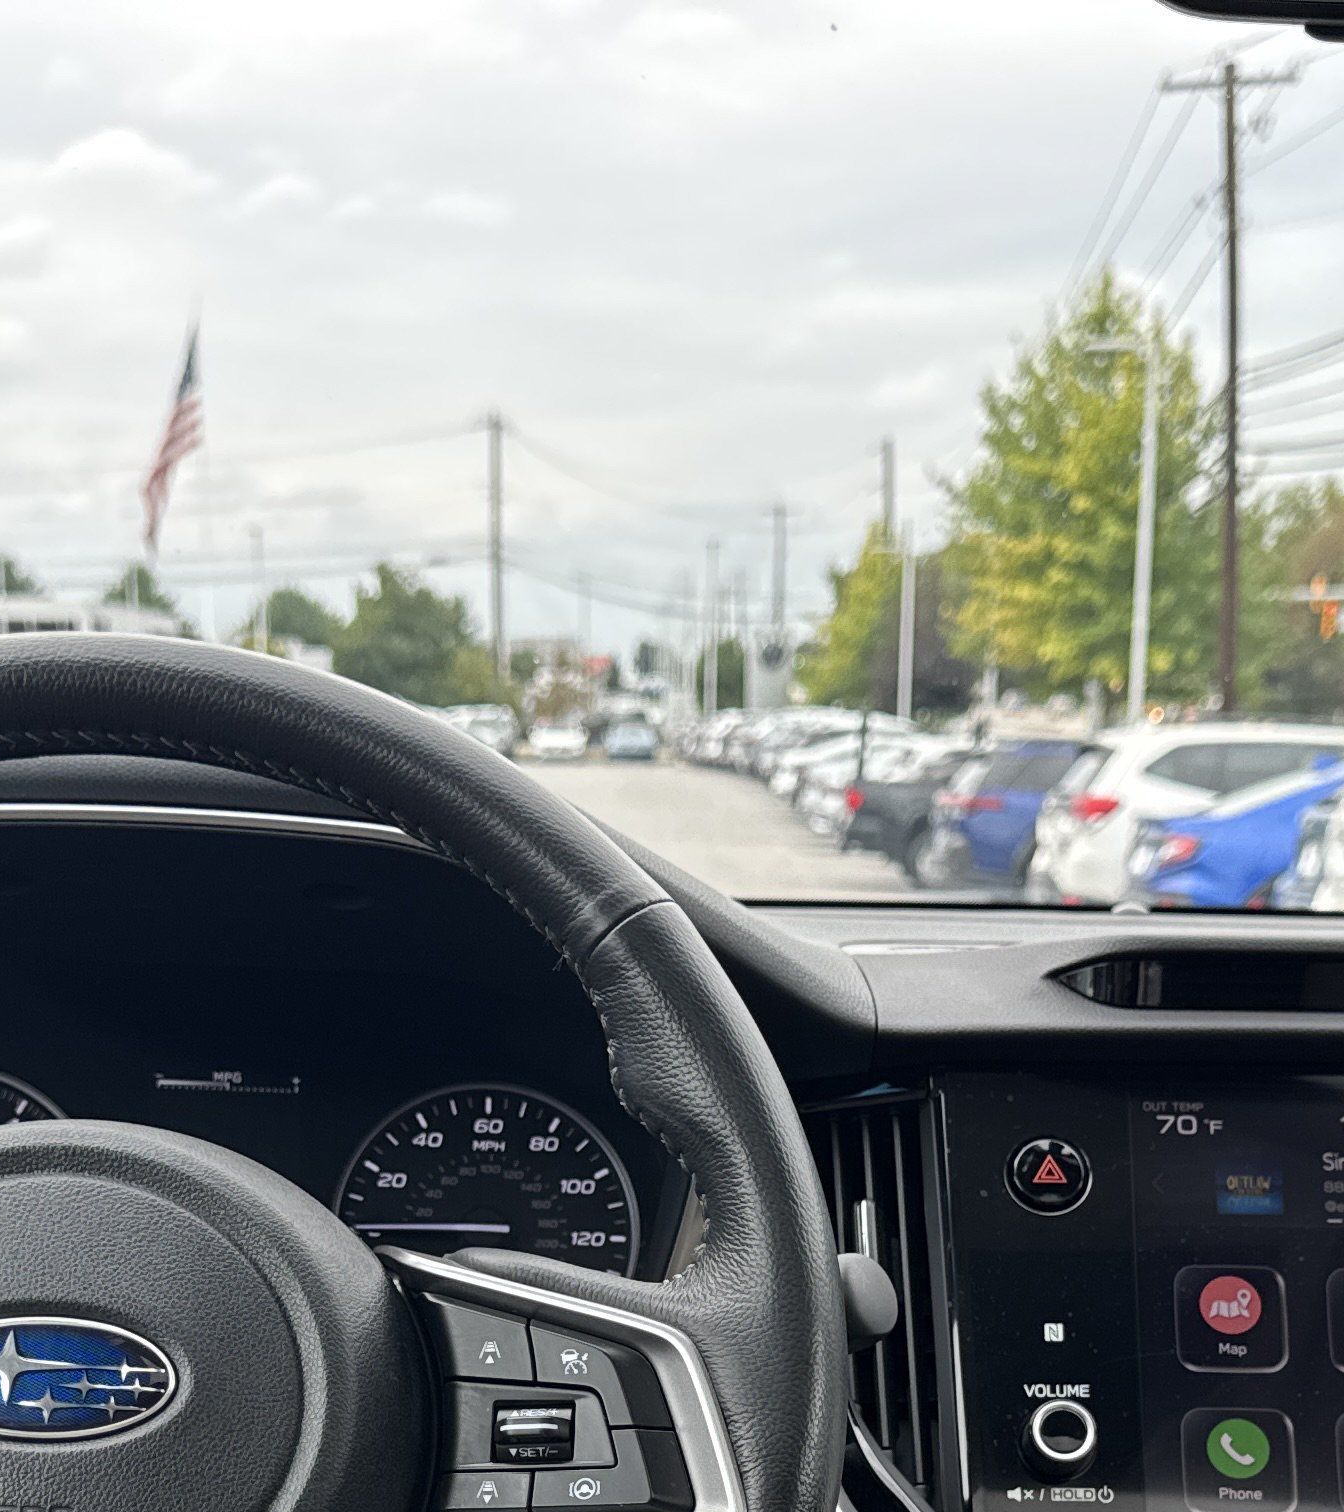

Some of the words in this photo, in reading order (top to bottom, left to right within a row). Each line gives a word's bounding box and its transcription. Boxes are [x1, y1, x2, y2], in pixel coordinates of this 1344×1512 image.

[1143, 1101, 1169, 1112] OUT
[1172, 1102, 1204, 1113] TEMP
[473, 1119, 505, 1135] 60
[1156, 1115, 1198, 1136] 70
[412, 1132, 444, 1149] 40
[472, 1139, 506, 1153] MPH
[529, 1136, 560, 1153] 80
[376, 1172, 408, 1189] 20
[560, 1178, 596, 1196] 100
[570, 1230, 606, 1248] 120
[1219, 1343, 1248, 1358] Map
[1024, 1384, 1091, 1399] VOLUME
[1052, 1488, 1095, 1501] HOLD
[1219, 1486, 1263, 1501] Phone
